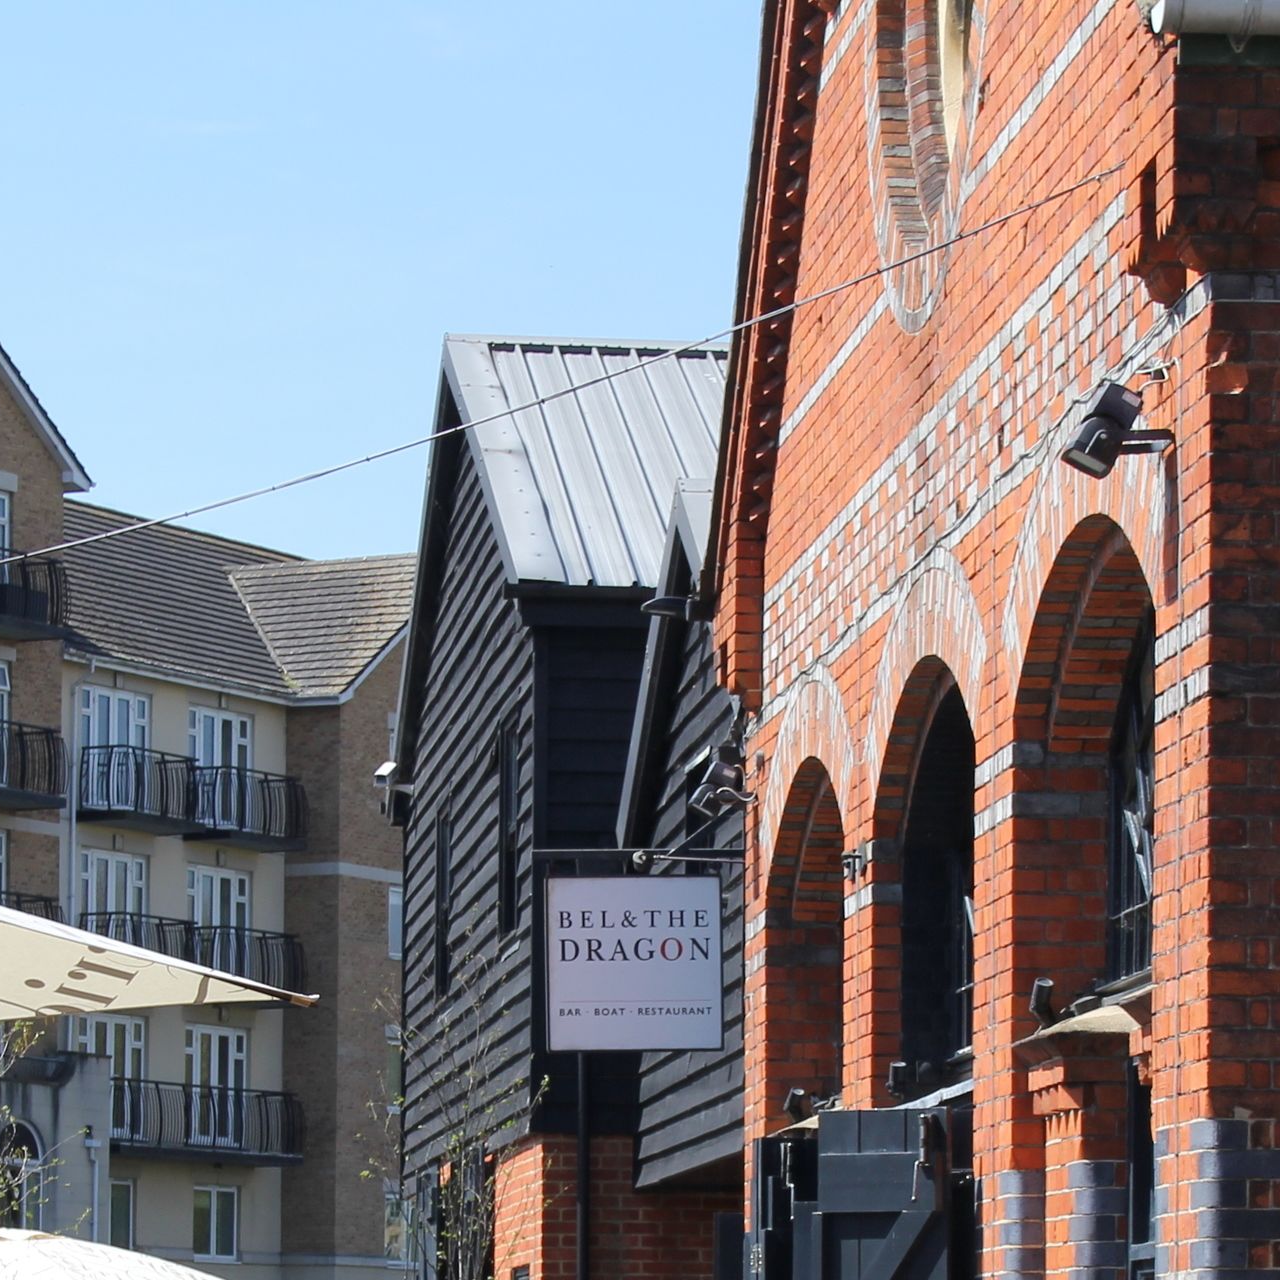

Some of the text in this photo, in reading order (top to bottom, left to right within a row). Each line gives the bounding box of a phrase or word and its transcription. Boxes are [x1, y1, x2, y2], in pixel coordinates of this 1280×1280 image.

[558, 937, 711, 962] DRAGON
[559, 1006, 713, 1017] BAR BOAT RESTAURANT
